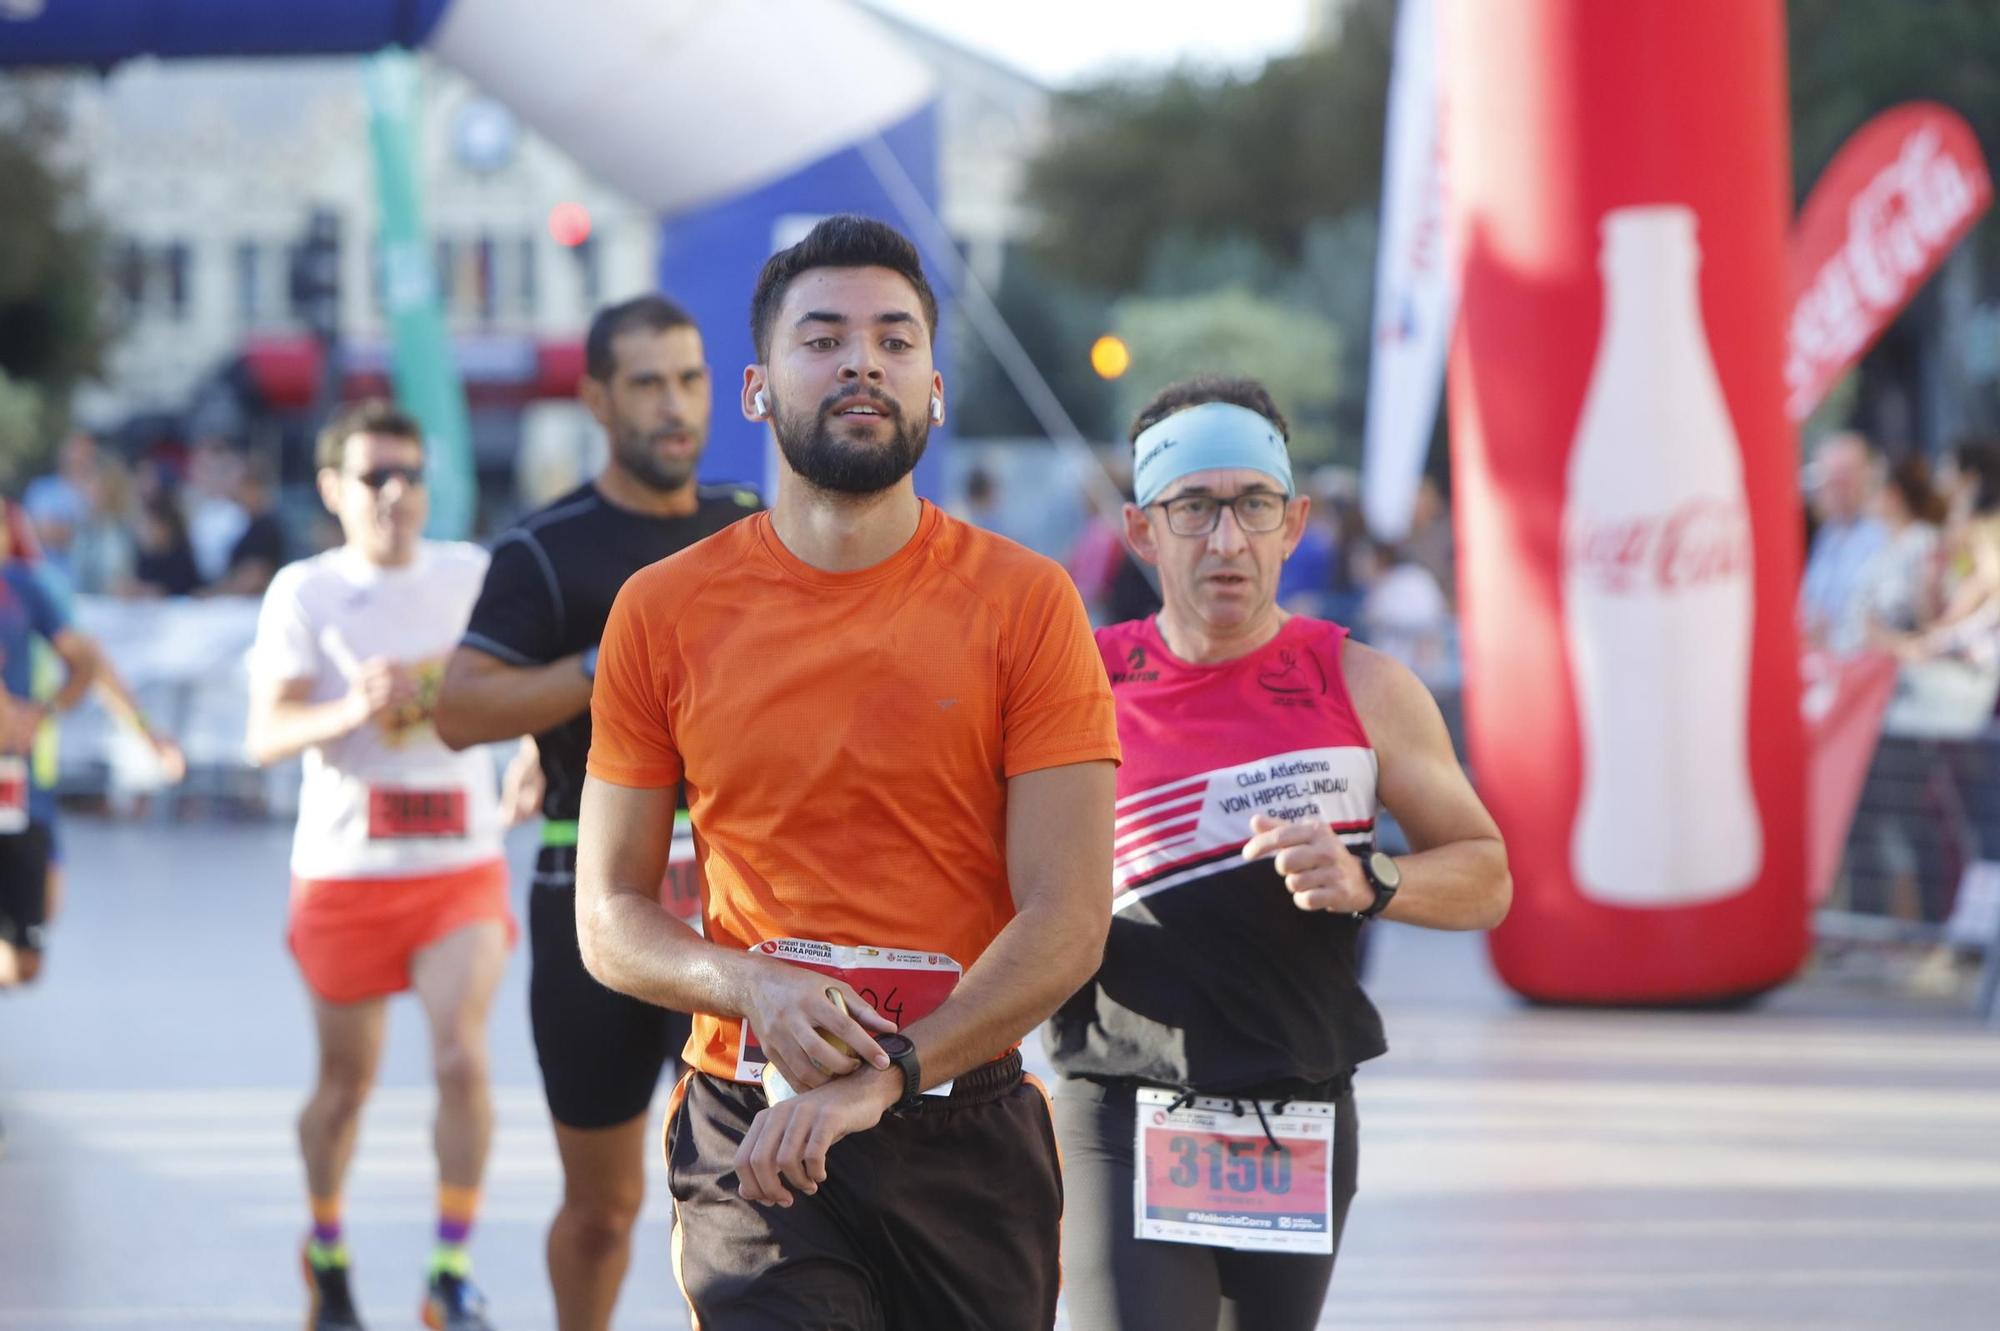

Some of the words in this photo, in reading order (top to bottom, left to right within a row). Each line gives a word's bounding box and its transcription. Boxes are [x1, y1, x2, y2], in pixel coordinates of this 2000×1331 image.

[1236, 768, 1267, 787] Club
[1270, 759, 1331, 780] Atletismo
[1219, 793, 1252, 815] VON
[1251, 777, 1349, 806] HIPPEL-LINDAU
[778, 945, 804, 954] CAIXA
[804, 949, 832, 958] POPULAR
[1168, 1135, 1292, 1195] 3150
